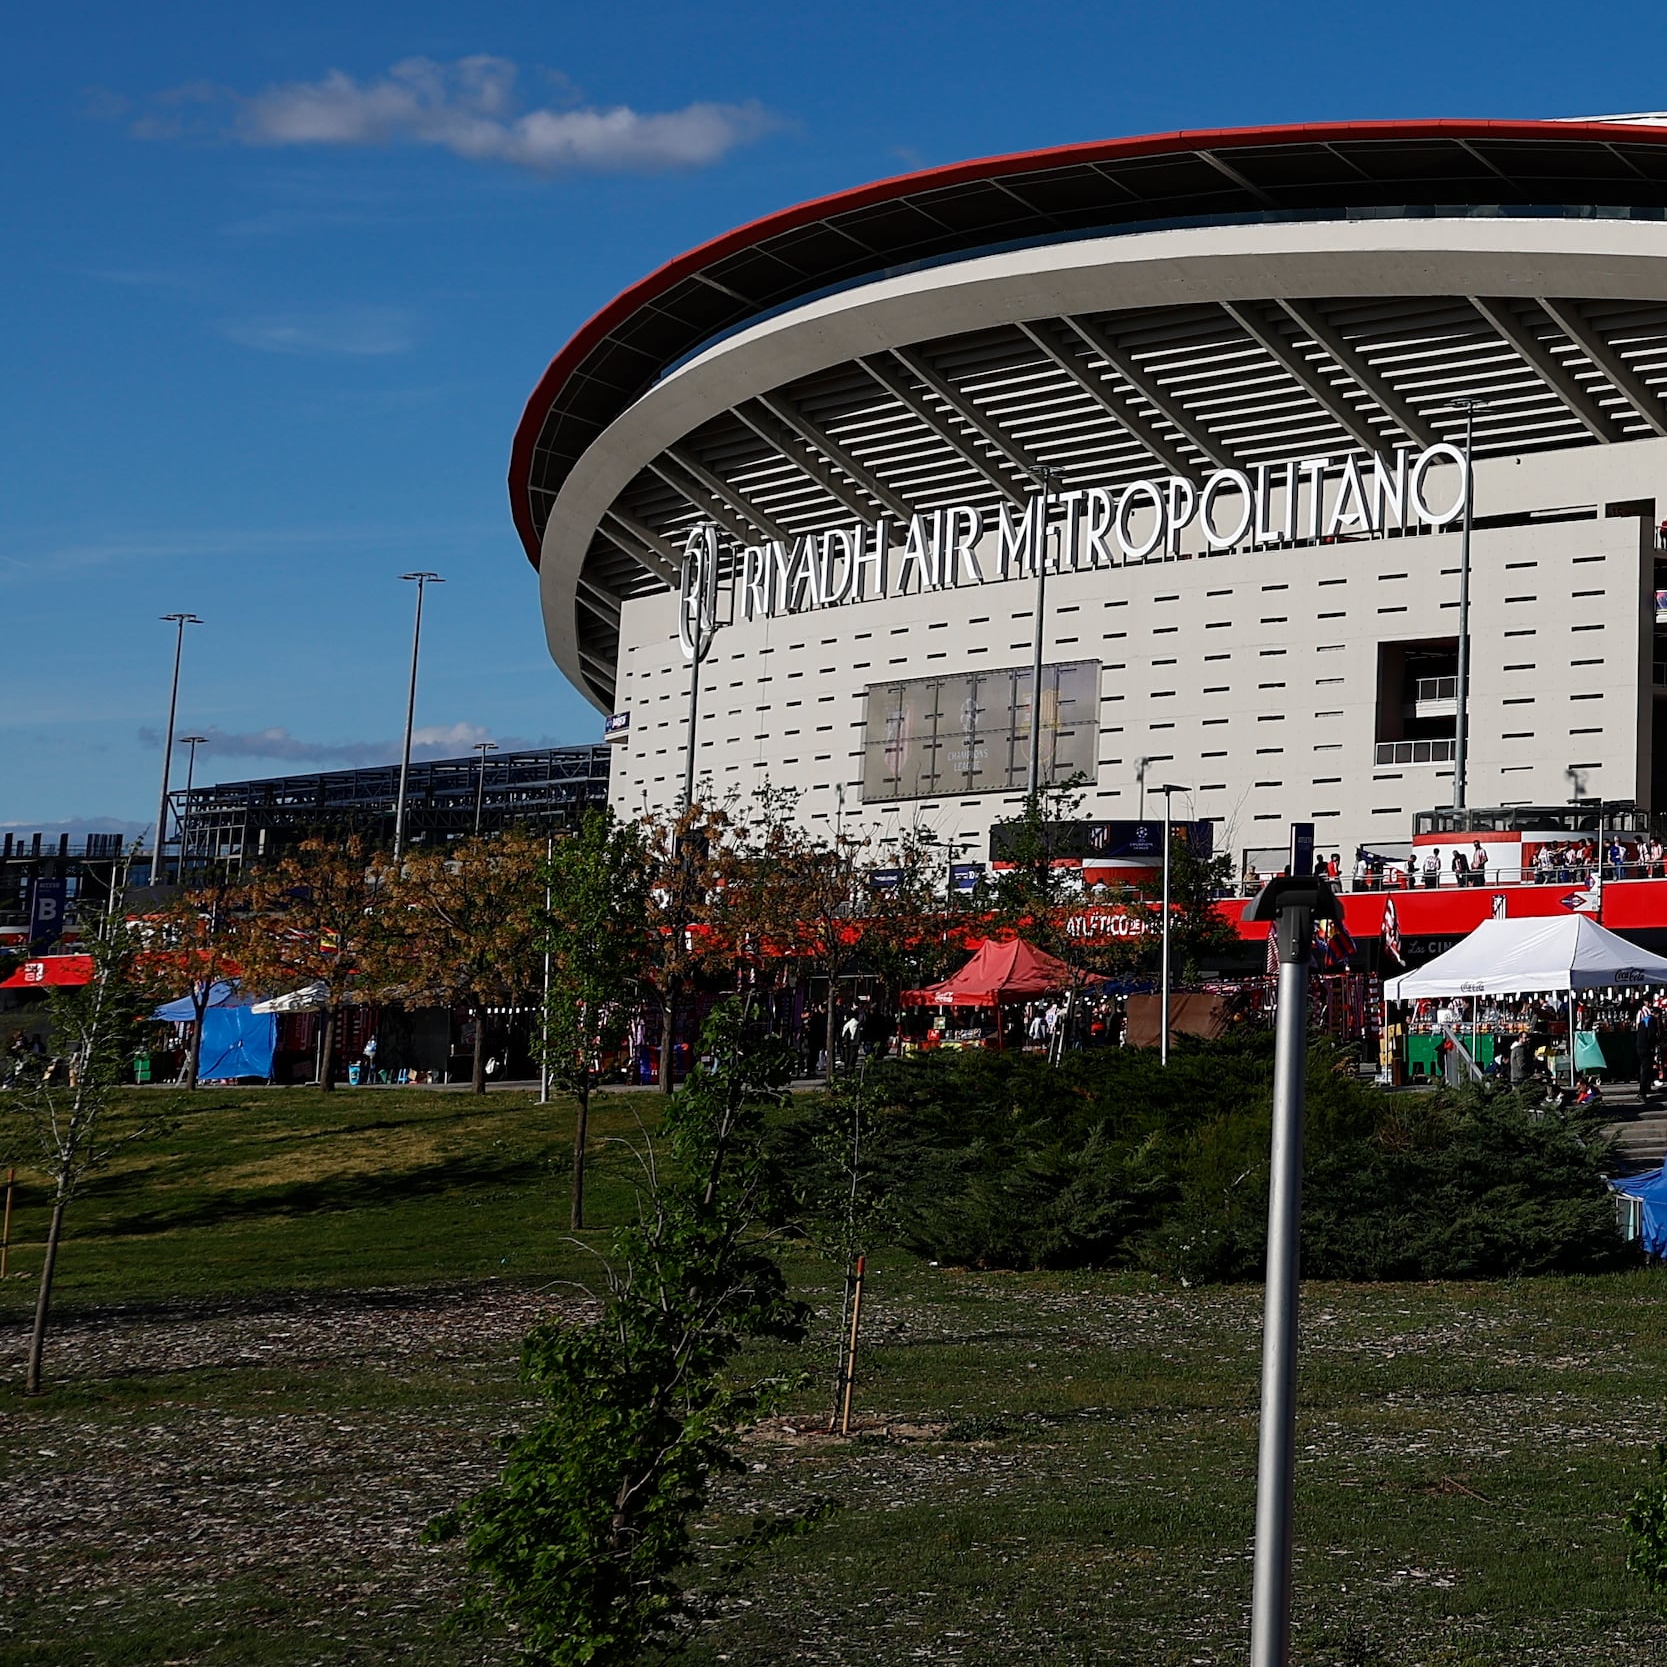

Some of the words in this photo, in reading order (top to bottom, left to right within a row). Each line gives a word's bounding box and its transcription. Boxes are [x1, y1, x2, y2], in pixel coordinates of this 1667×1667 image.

[741, 519, 889, 622] RIYADH
[897, 505, 984, 595] AIR
[996, 443, 1471, 575] METROPOLITANO
[38, 898, 57, 921] B
